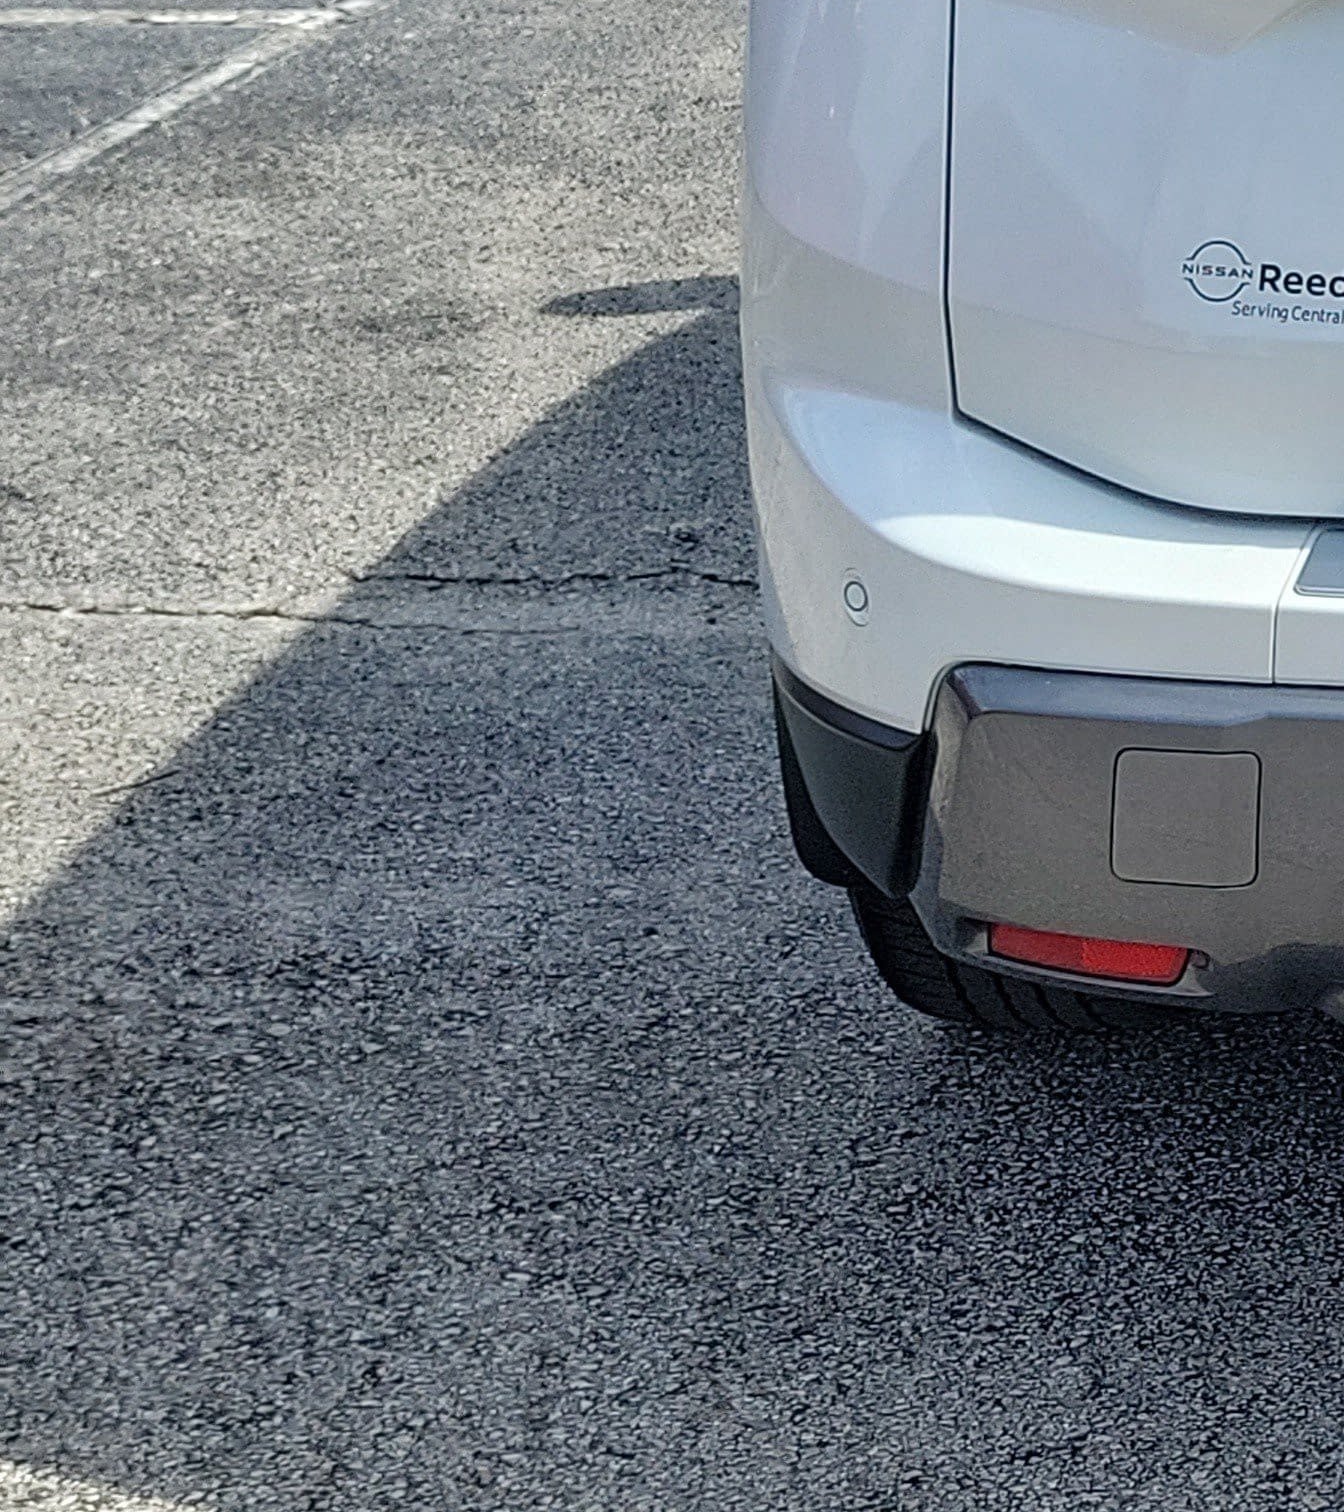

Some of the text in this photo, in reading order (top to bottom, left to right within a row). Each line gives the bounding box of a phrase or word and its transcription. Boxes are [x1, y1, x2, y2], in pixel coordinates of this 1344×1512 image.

[1181, 263, 1254, 279] NISSAN
[1231, 300, 1288, 323] Serving
[1291, 306, 1344, 324] Central
